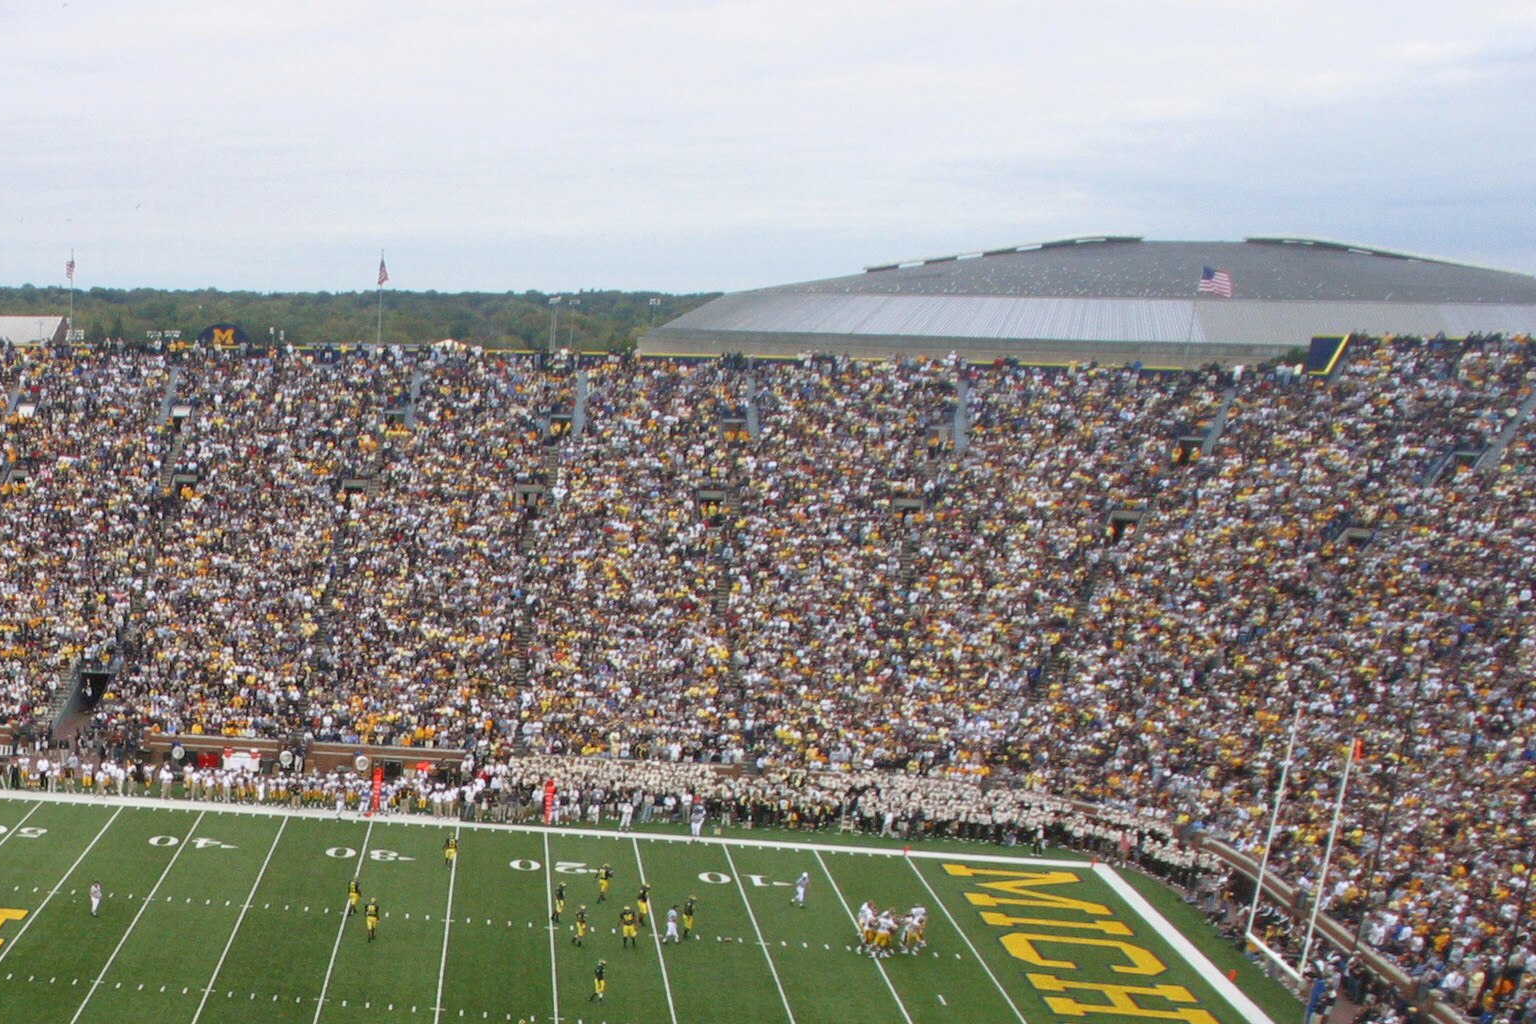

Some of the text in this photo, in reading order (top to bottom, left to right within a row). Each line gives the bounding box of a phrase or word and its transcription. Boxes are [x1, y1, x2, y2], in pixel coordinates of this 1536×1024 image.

[212, 327, 235, 344] M
[325, 847, 399, 860] 30
[509, 859, 588, 873] 20
